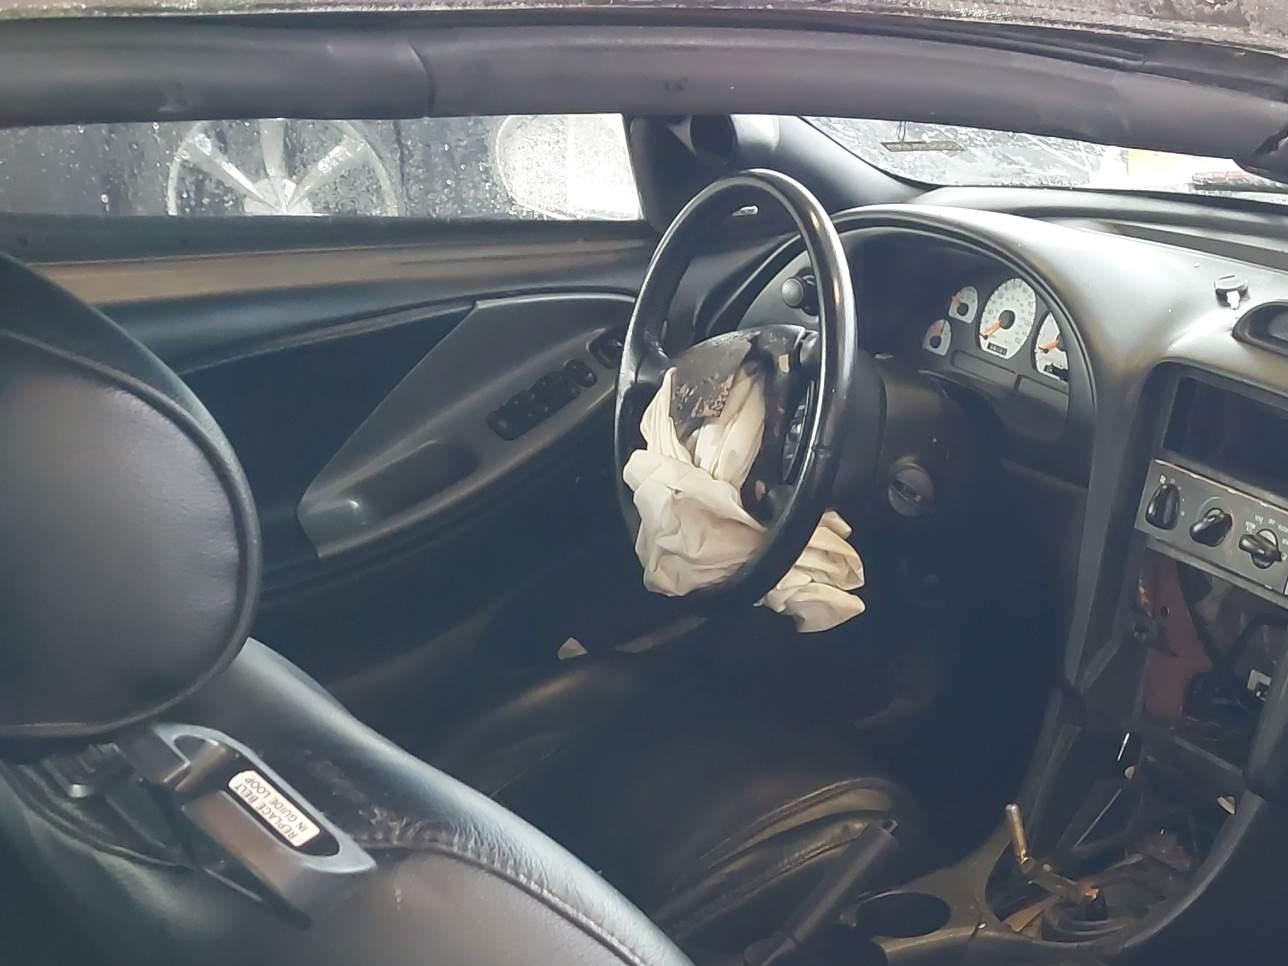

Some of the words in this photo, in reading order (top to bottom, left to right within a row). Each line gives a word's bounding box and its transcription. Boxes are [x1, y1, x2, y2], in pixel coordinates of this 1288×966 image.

[234, 783, 258, 804] BELT
[244, 777, 271, 798] LOOP
[269, 797, 298, 822] GUIDE
[256, 802, 298, 839] REPLACE
[296, 821, 309, 833] IN
